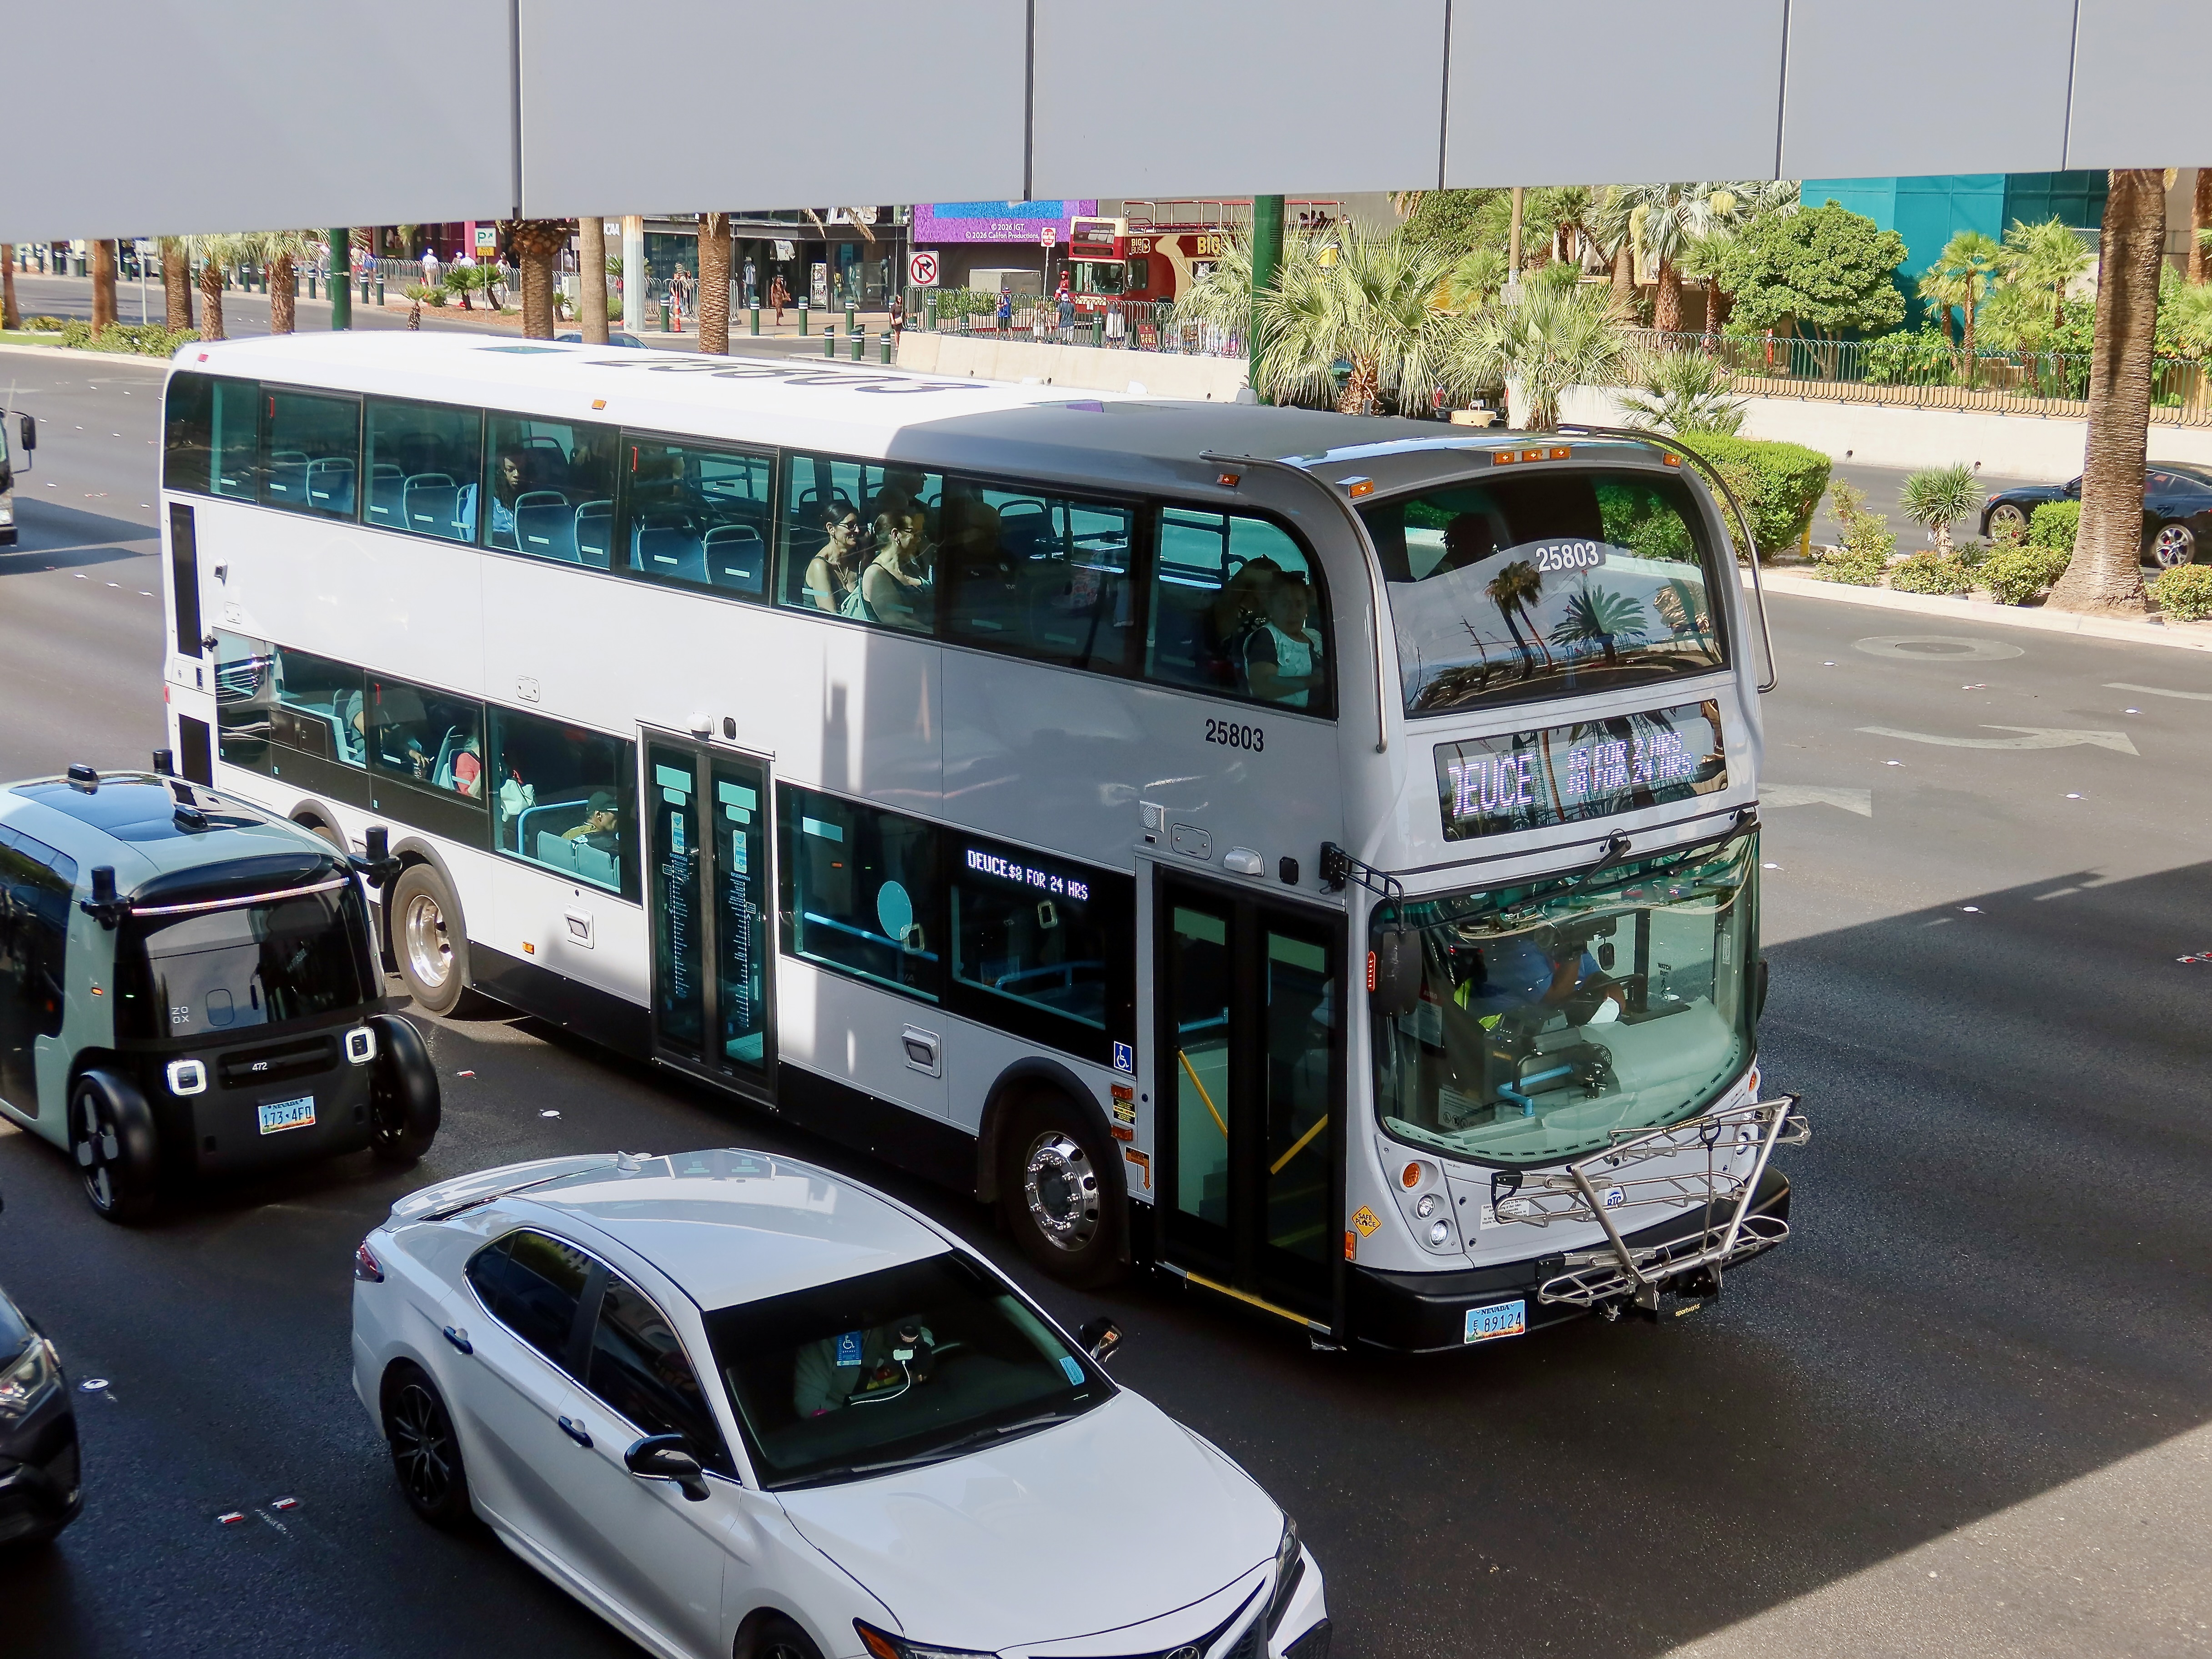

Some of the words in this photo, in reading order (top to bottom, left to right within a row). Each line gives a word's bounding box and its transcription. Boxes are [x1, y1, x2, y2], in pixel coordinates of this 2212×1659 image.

[1008, 231, 1040, 240] Productions,
[1131, 238, 1142, 246] BIG
[1197, 236, 1220, 255] BIG
[1535, 541, 1599, 572] 25803
[1205, 719, 1264, 753] 25803
[1594, 740, 1629, 767] FOR
[1631, 737, 1644, 761] 2
[1649, 731, 1683, 757] HRS
[1593, 765, 1627, 793] FOR
[1631, 759, 1655, 785] 24
[1658, 752, 1693, 779] HRS
[1026, 868, 1046, 890] FOR
[1050, 875, 1064, 894] 24
[1067, 880, 1089, 901] HRS
[171, 1006, 188, 1015] ZO
[173, 1015, 189, 1024] OX
[252, 1062, 268, 1071] 472
[273, 1101, 299, 1110] NEVADA
[1358, 1213, 1372, 1221] SAFE
[1481, 1305, 1510, 1315] NEVADA
[1484, 1312, 1521, 1332] 89124
